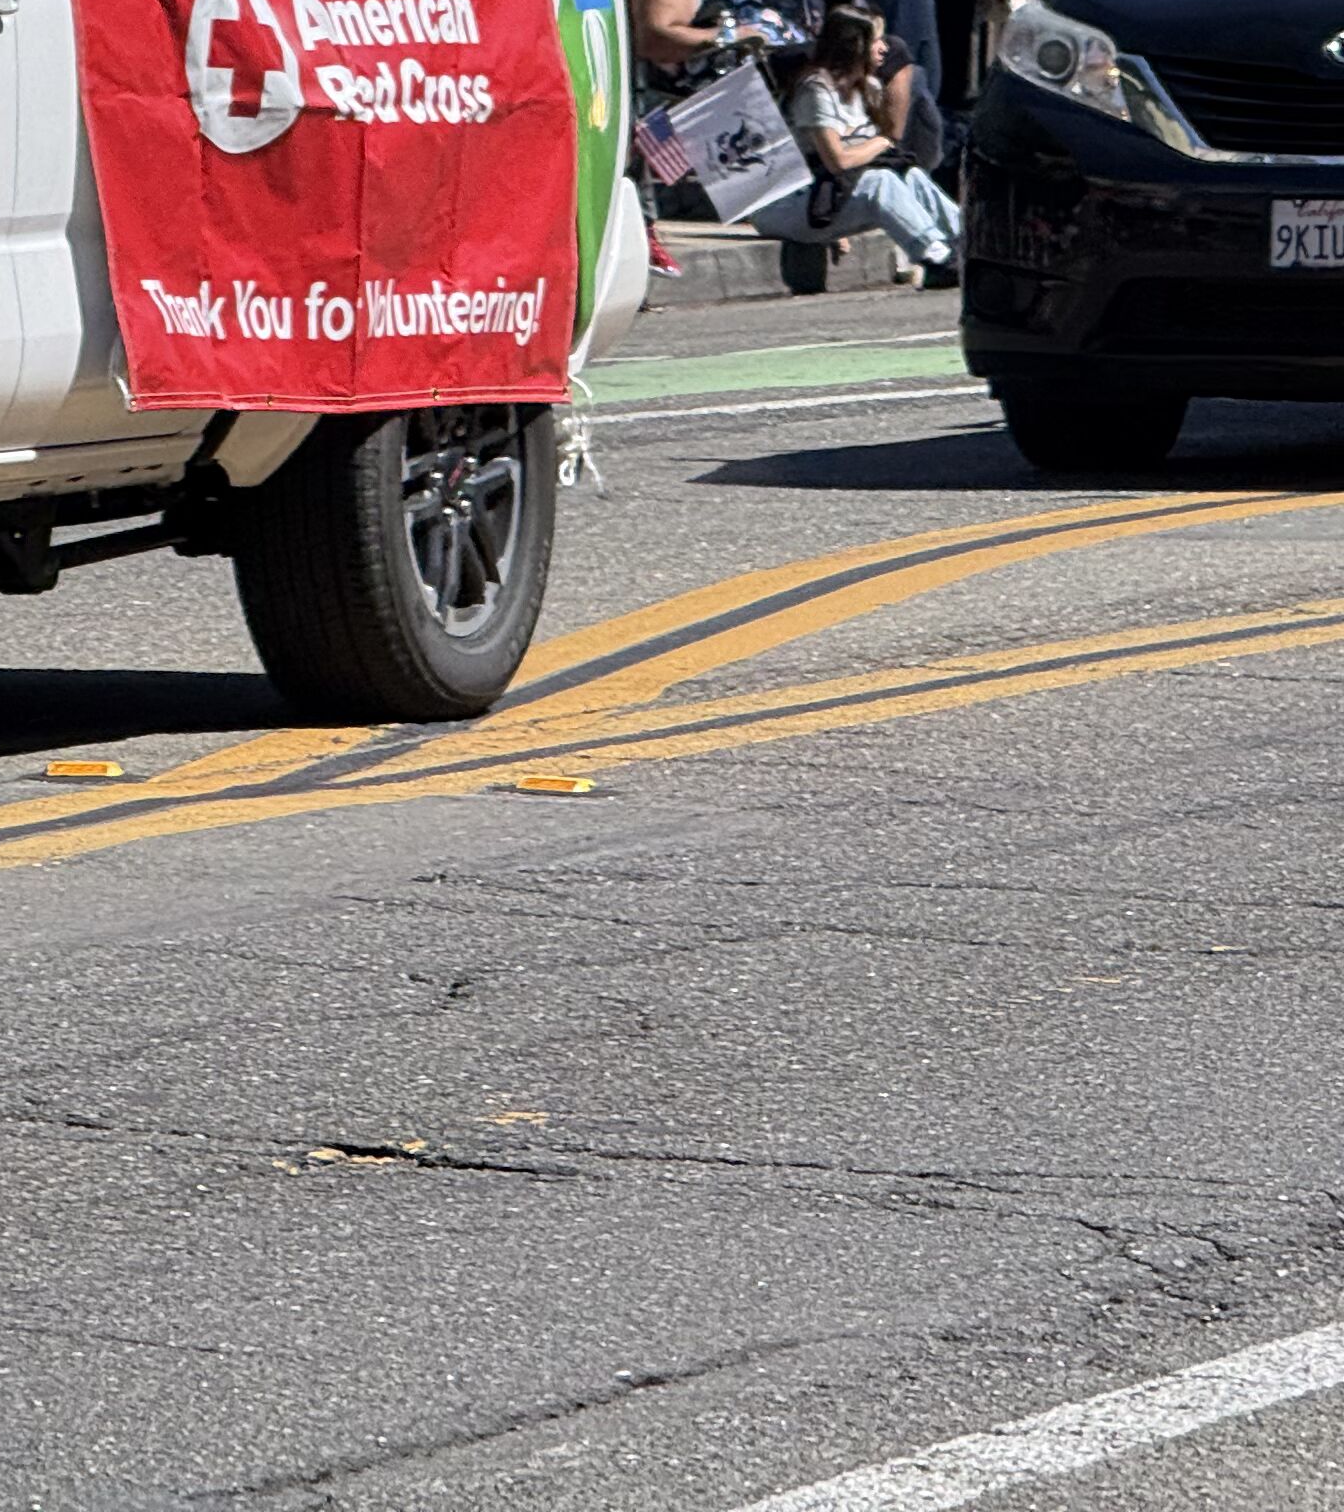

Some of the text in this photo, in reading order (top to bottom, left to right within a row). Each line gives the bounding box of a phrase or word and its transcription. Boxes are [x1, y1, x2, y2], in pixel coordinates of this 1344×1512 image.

[317, 58, 493, 125] Red Cross
[140, 277, 227, 340] Thank
[232, 279, 293, 341] You
